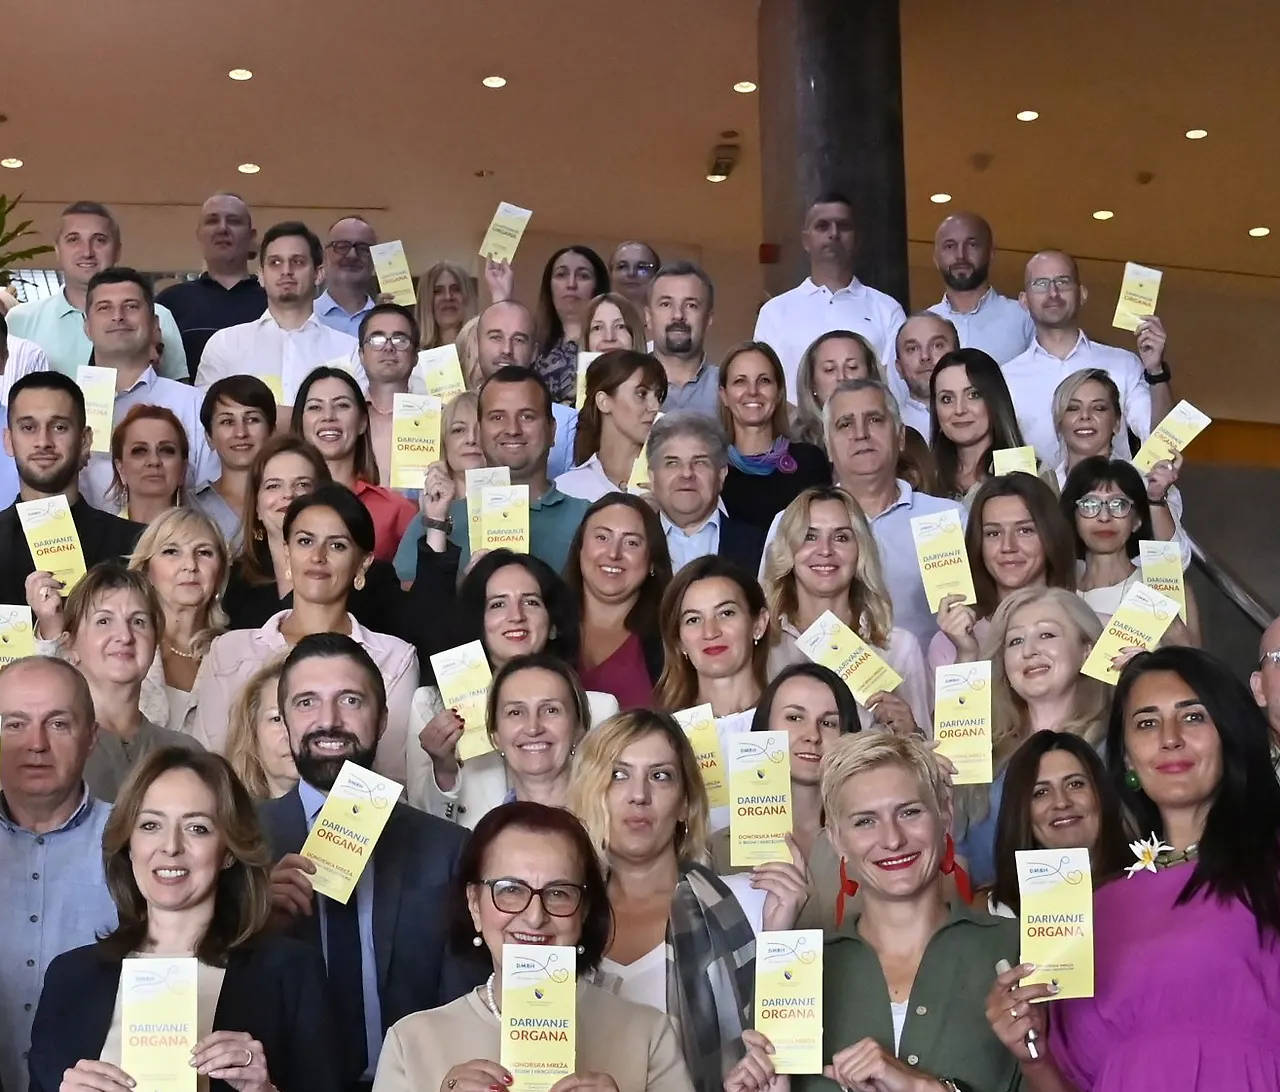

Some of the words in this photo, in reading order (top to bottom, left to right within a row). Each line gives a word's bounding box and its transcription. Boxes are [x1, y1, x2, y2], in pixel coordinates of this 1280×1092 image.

[397, 436, 436, 445] DARIVANJE
[397, 444, 435, 453] ORGANA
[33, 536, 74, 548] DARIVANJE
[487, 535, 524, 543] ORGANA
[36, 543, 75, 556] ORGANA
[923, 550, 961, 562] DARIVANJE
[924, 558, 963, 571] ORGANA
[1147, 583, 1180, 592] ORGANA
[1112, 619, 1153, 643] DARIVANJE
[1107, 627, 1147, 651] ORGANA
[841, 651, 872, 681] ORGANA
[939, 718, 985, 728] DARIVANJE
[939, 726, 986, 739] ORGANA
[736, 795, 786, 806] DARIVANJE
[736, 806, 787, 817] ORGANA
[321, 819, 370, 846] DARIVANJE
[316, 828, 364, 857] ORGANA
[1026, 914, 1084, 925] DARIVANJE
[1026, 926, 1084, 938] ORGANA
[761, 997, 816, 1007] DARIVANJE
[761, 1008, 815, 1020] ORGANA
[129, 1023, 189, 1034] DARIVANJE
[509, 1017, 569, 1029] DARIVANJE
[129, 1035, 188, 1047] ORGANA
[509, 1029, 568, 1042] ORGANA
[546, 1061, 568, 1069] MREŽA
